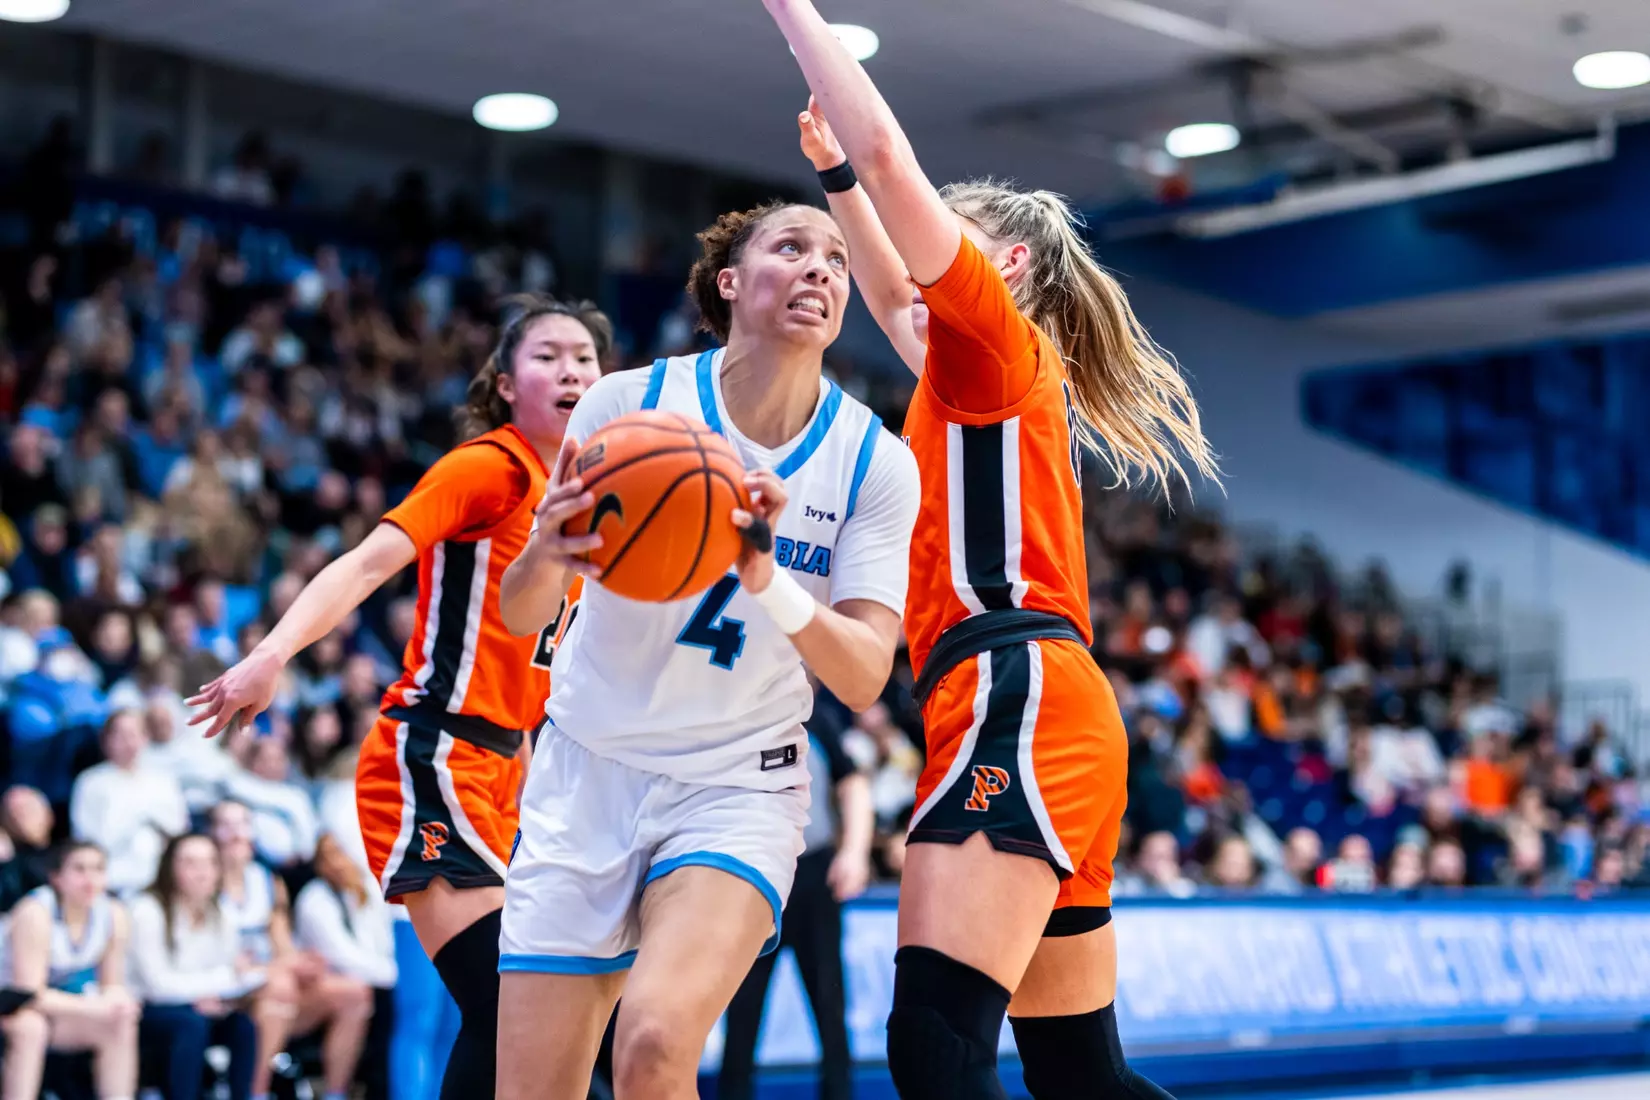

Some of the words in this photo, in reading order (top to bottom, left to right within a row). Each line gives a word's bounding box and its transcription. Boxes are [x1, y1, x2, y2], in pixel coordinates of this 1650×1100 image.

[804, 505, 827, 522] Ivy
[775, 535, 831, 577] BIA
[675, 572, 747, 671] 4
[965, 764, 1010, 812] P
[419, 821, 450, 862] P
